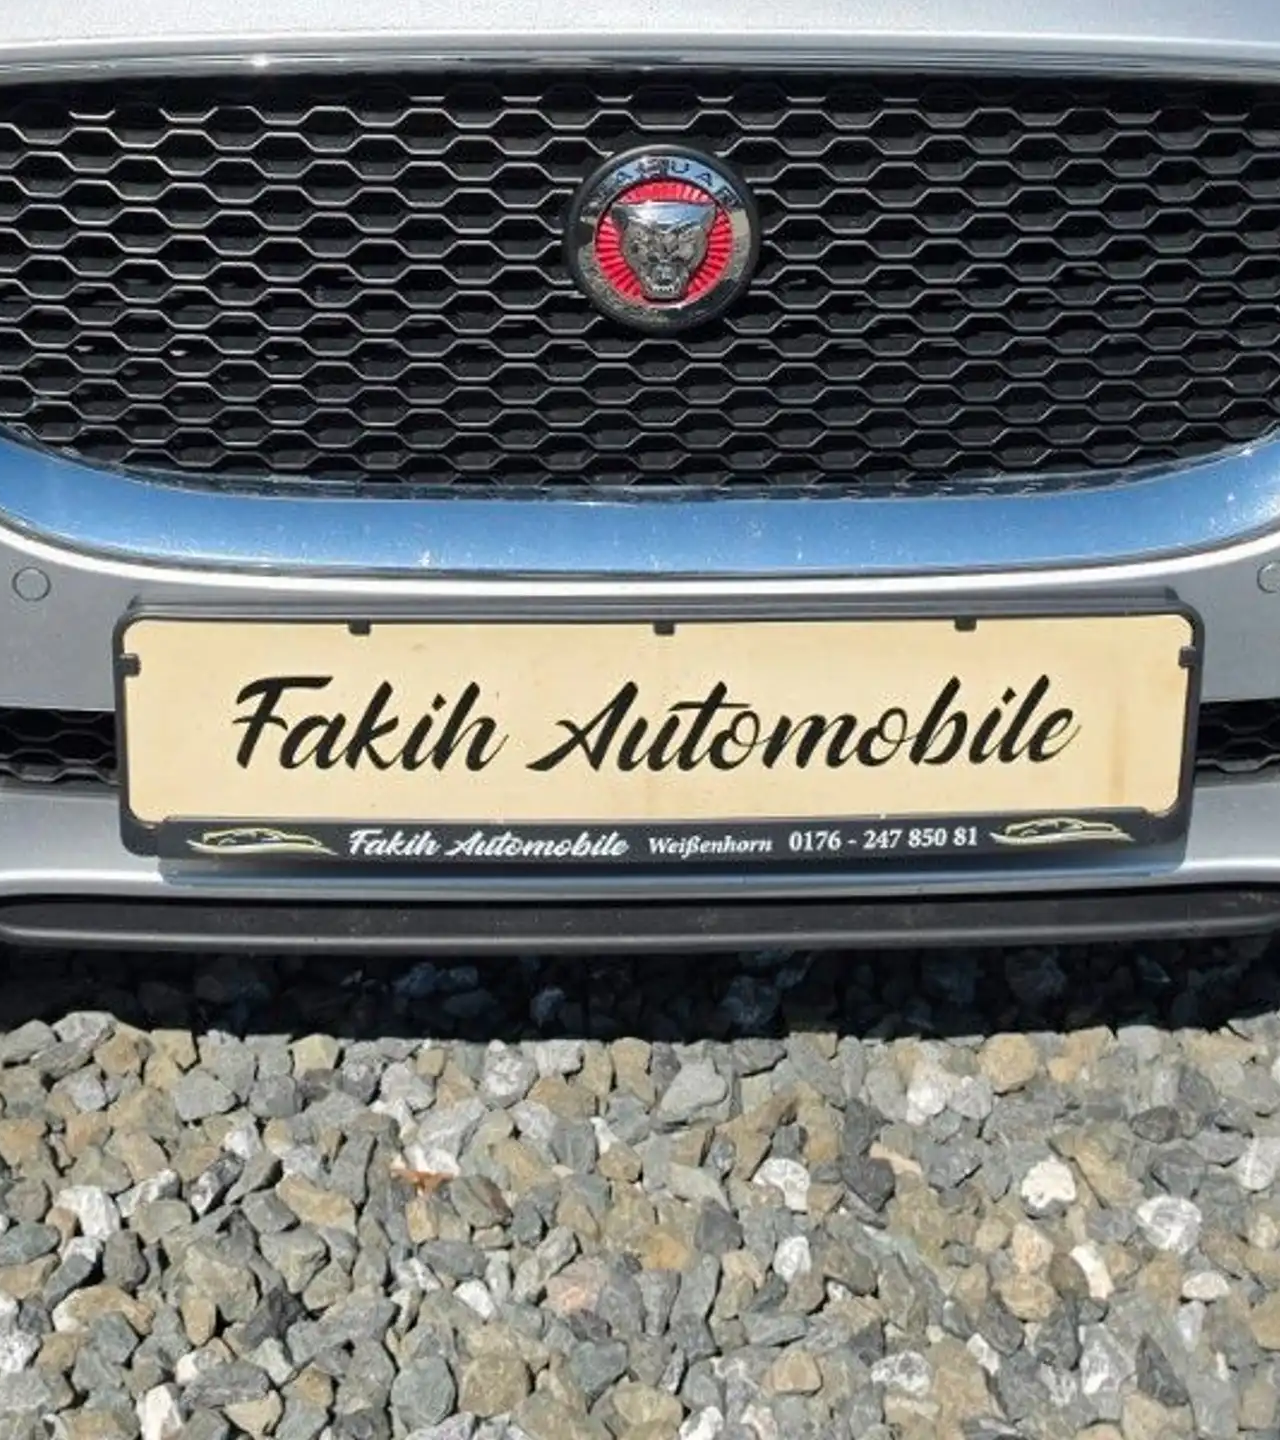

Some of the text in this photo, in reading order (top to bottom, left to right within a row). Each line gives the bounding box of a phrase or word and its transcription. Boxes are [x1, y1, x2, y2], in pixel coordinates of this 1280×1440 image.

[231, 673, 1081, 773] Fakih Automobile
[348, 828, 441, 857] Fakih
[444, 829, 630, 858] Automobile
[648, 834, 773, 860] Weißenhorn
[788, 829, 843, 852] 0176
[862, 828, 903, 850] 247
[907, 827, 948, 849] 850
[952, 826, 978, 847] 81
